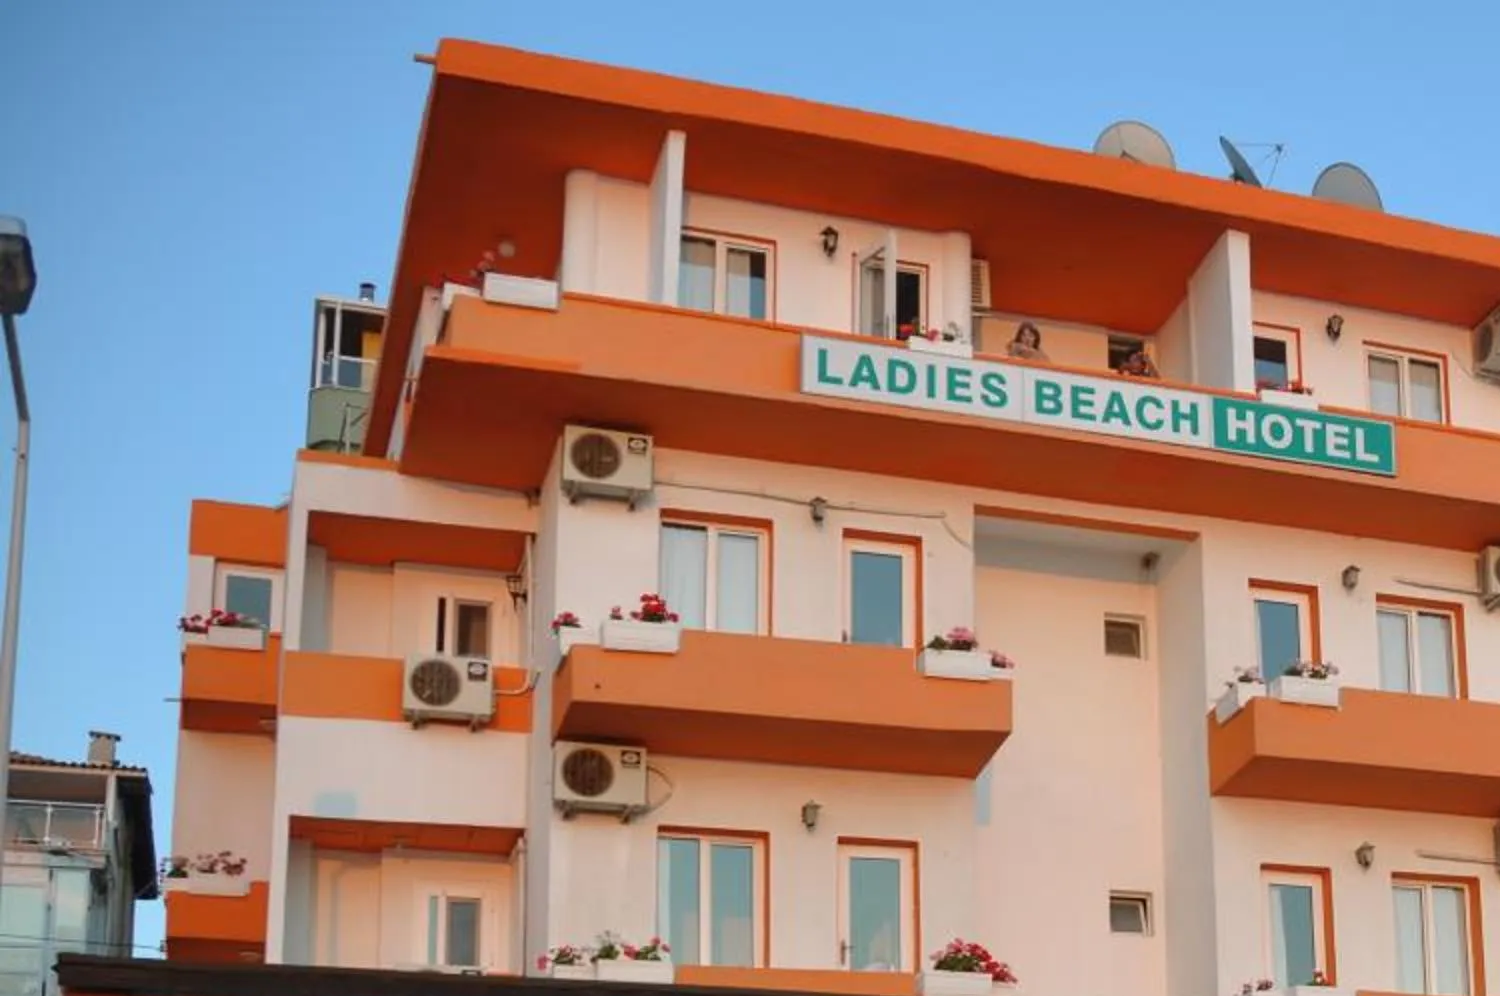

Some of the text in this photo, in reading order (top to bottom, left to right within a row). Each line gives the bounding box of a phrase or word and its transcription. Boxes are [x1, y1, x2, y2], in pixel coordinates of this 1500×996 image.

[816, 347, 1380, 464] LADIES BEACH HOTEL
